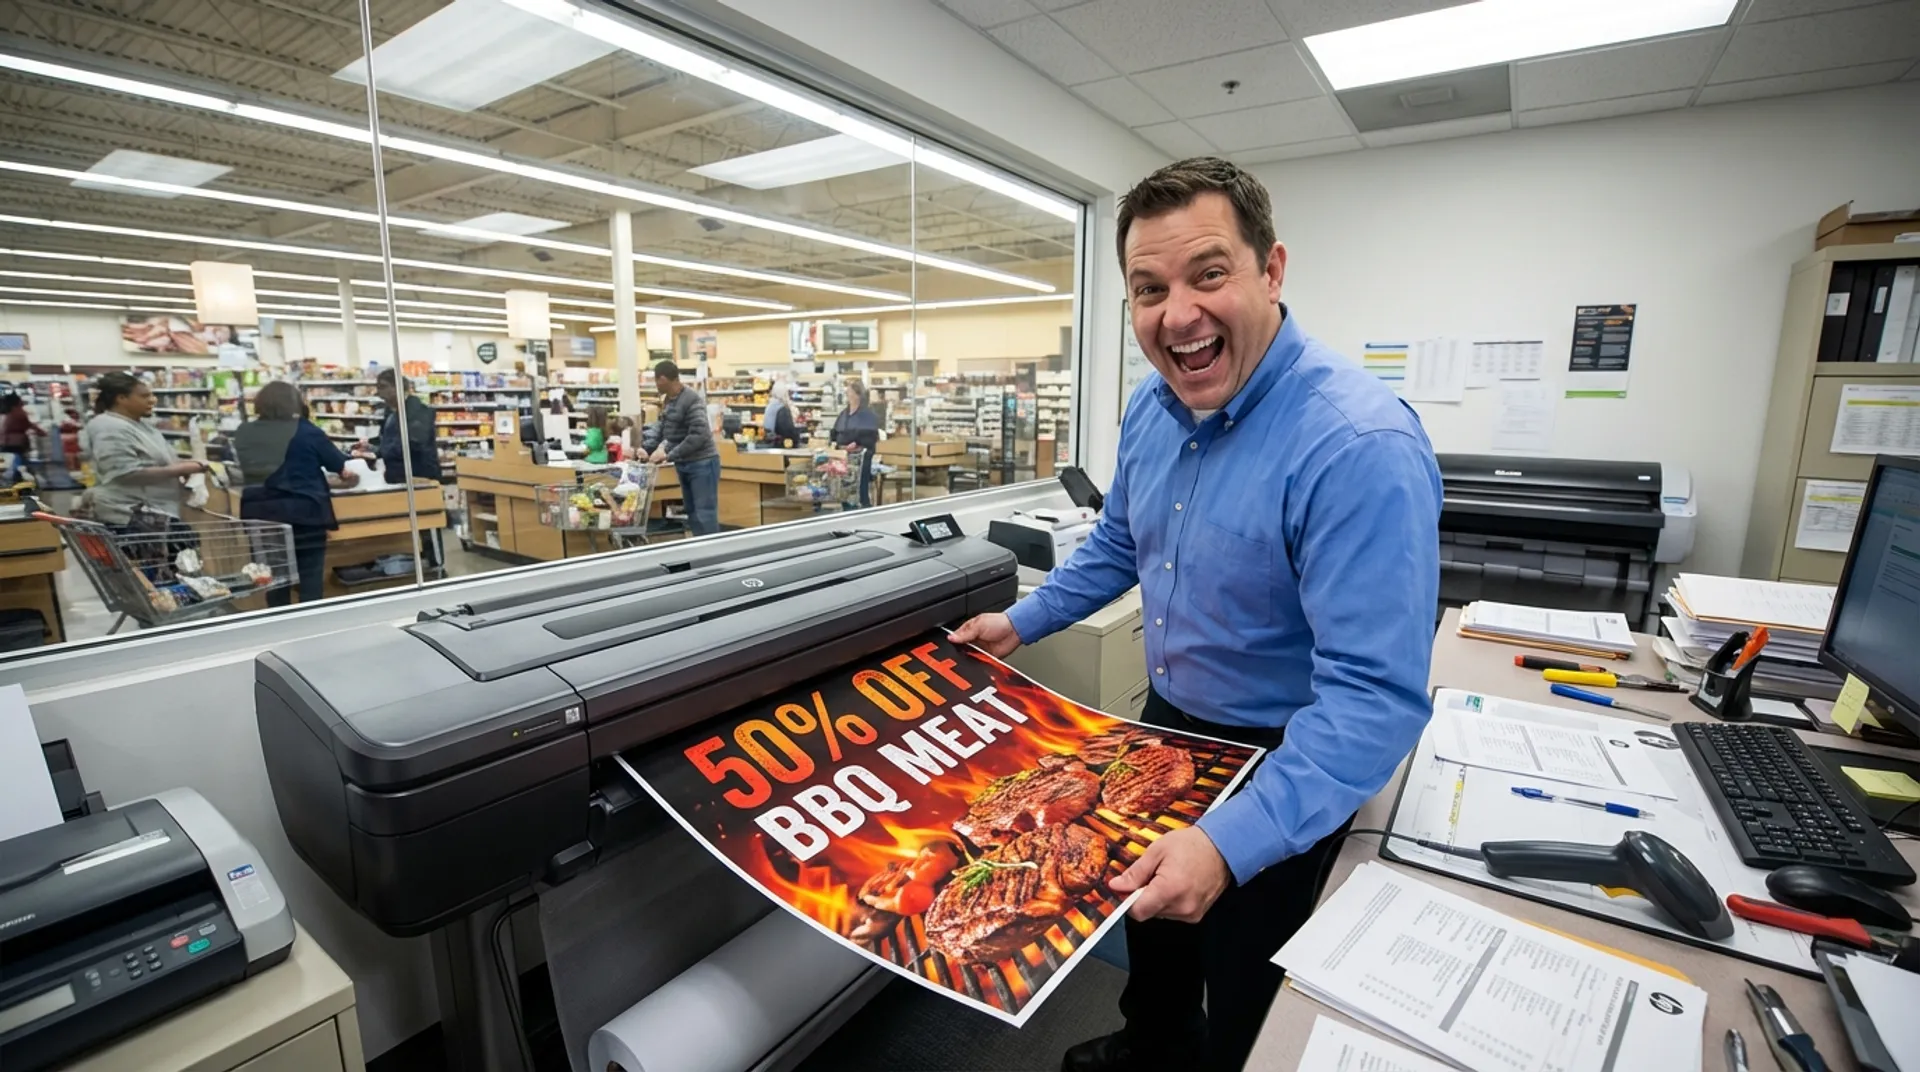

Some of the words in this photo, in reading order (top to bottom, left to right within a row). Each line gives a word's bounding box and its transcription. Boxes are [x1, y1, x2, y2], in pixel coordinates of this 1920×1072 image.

[685, 691, 878, 809] 50%
[852, 642, 972, 721] OFF
[754, 764, 912, 862] BBQ
[877, 686, 1029, 785] MEAT
